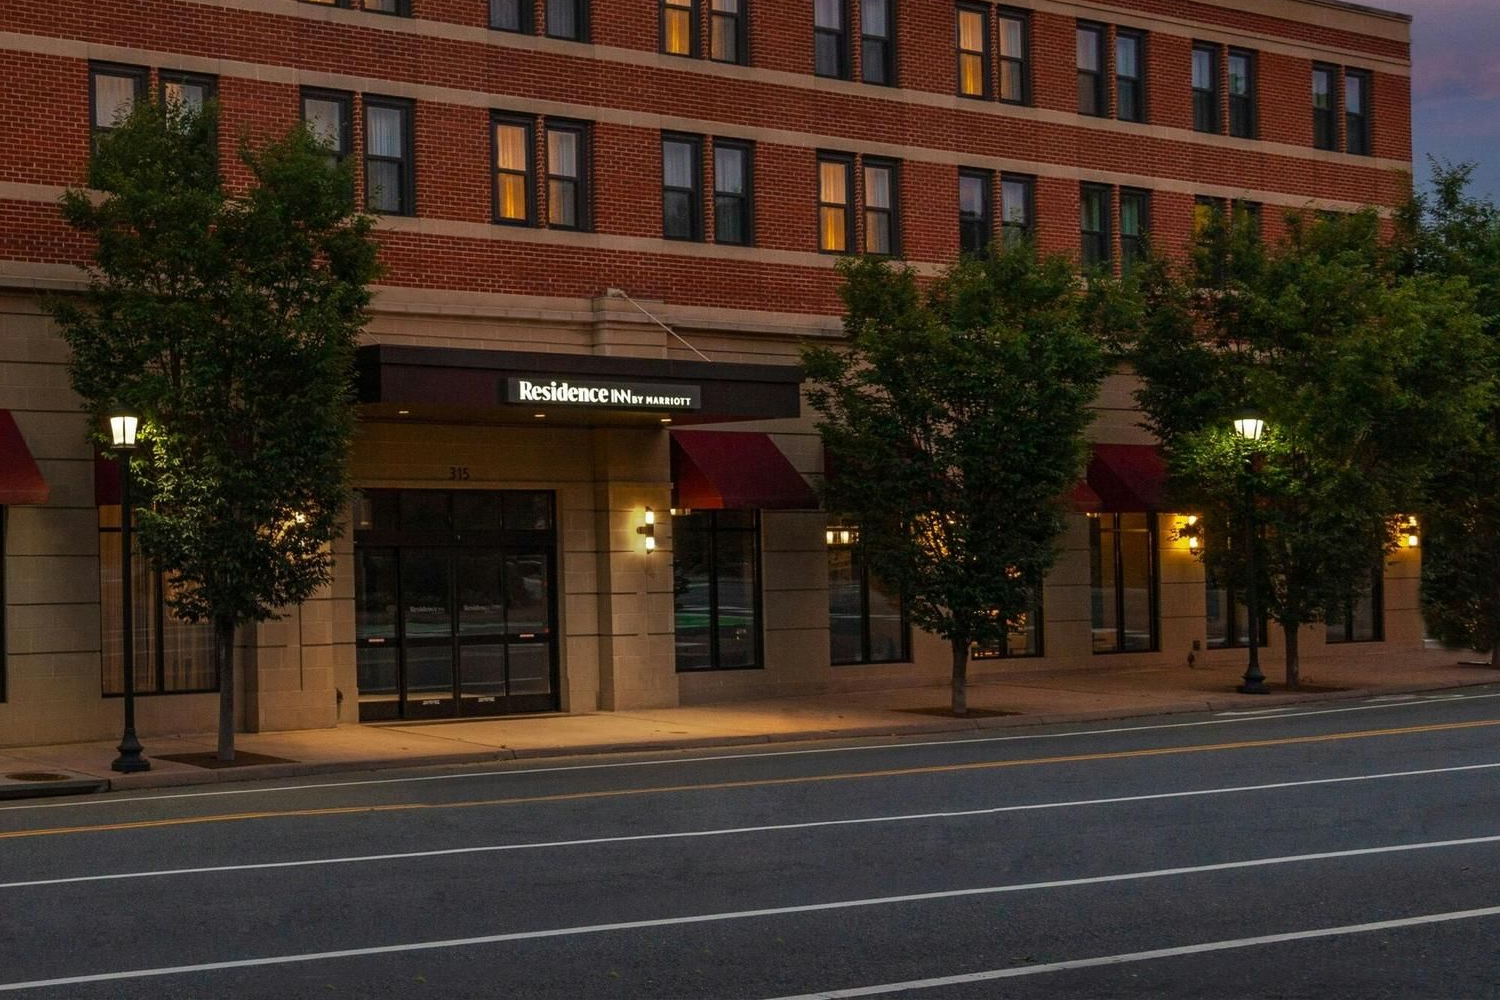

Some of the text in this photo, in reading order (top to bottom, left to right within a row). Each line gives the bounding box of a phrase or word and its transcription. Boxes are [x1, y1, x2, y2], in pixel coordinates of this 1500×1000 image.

[519, 381, 692, 406] Residence INN BY MARRIOTT
[450, 466, 470, 481] 315
